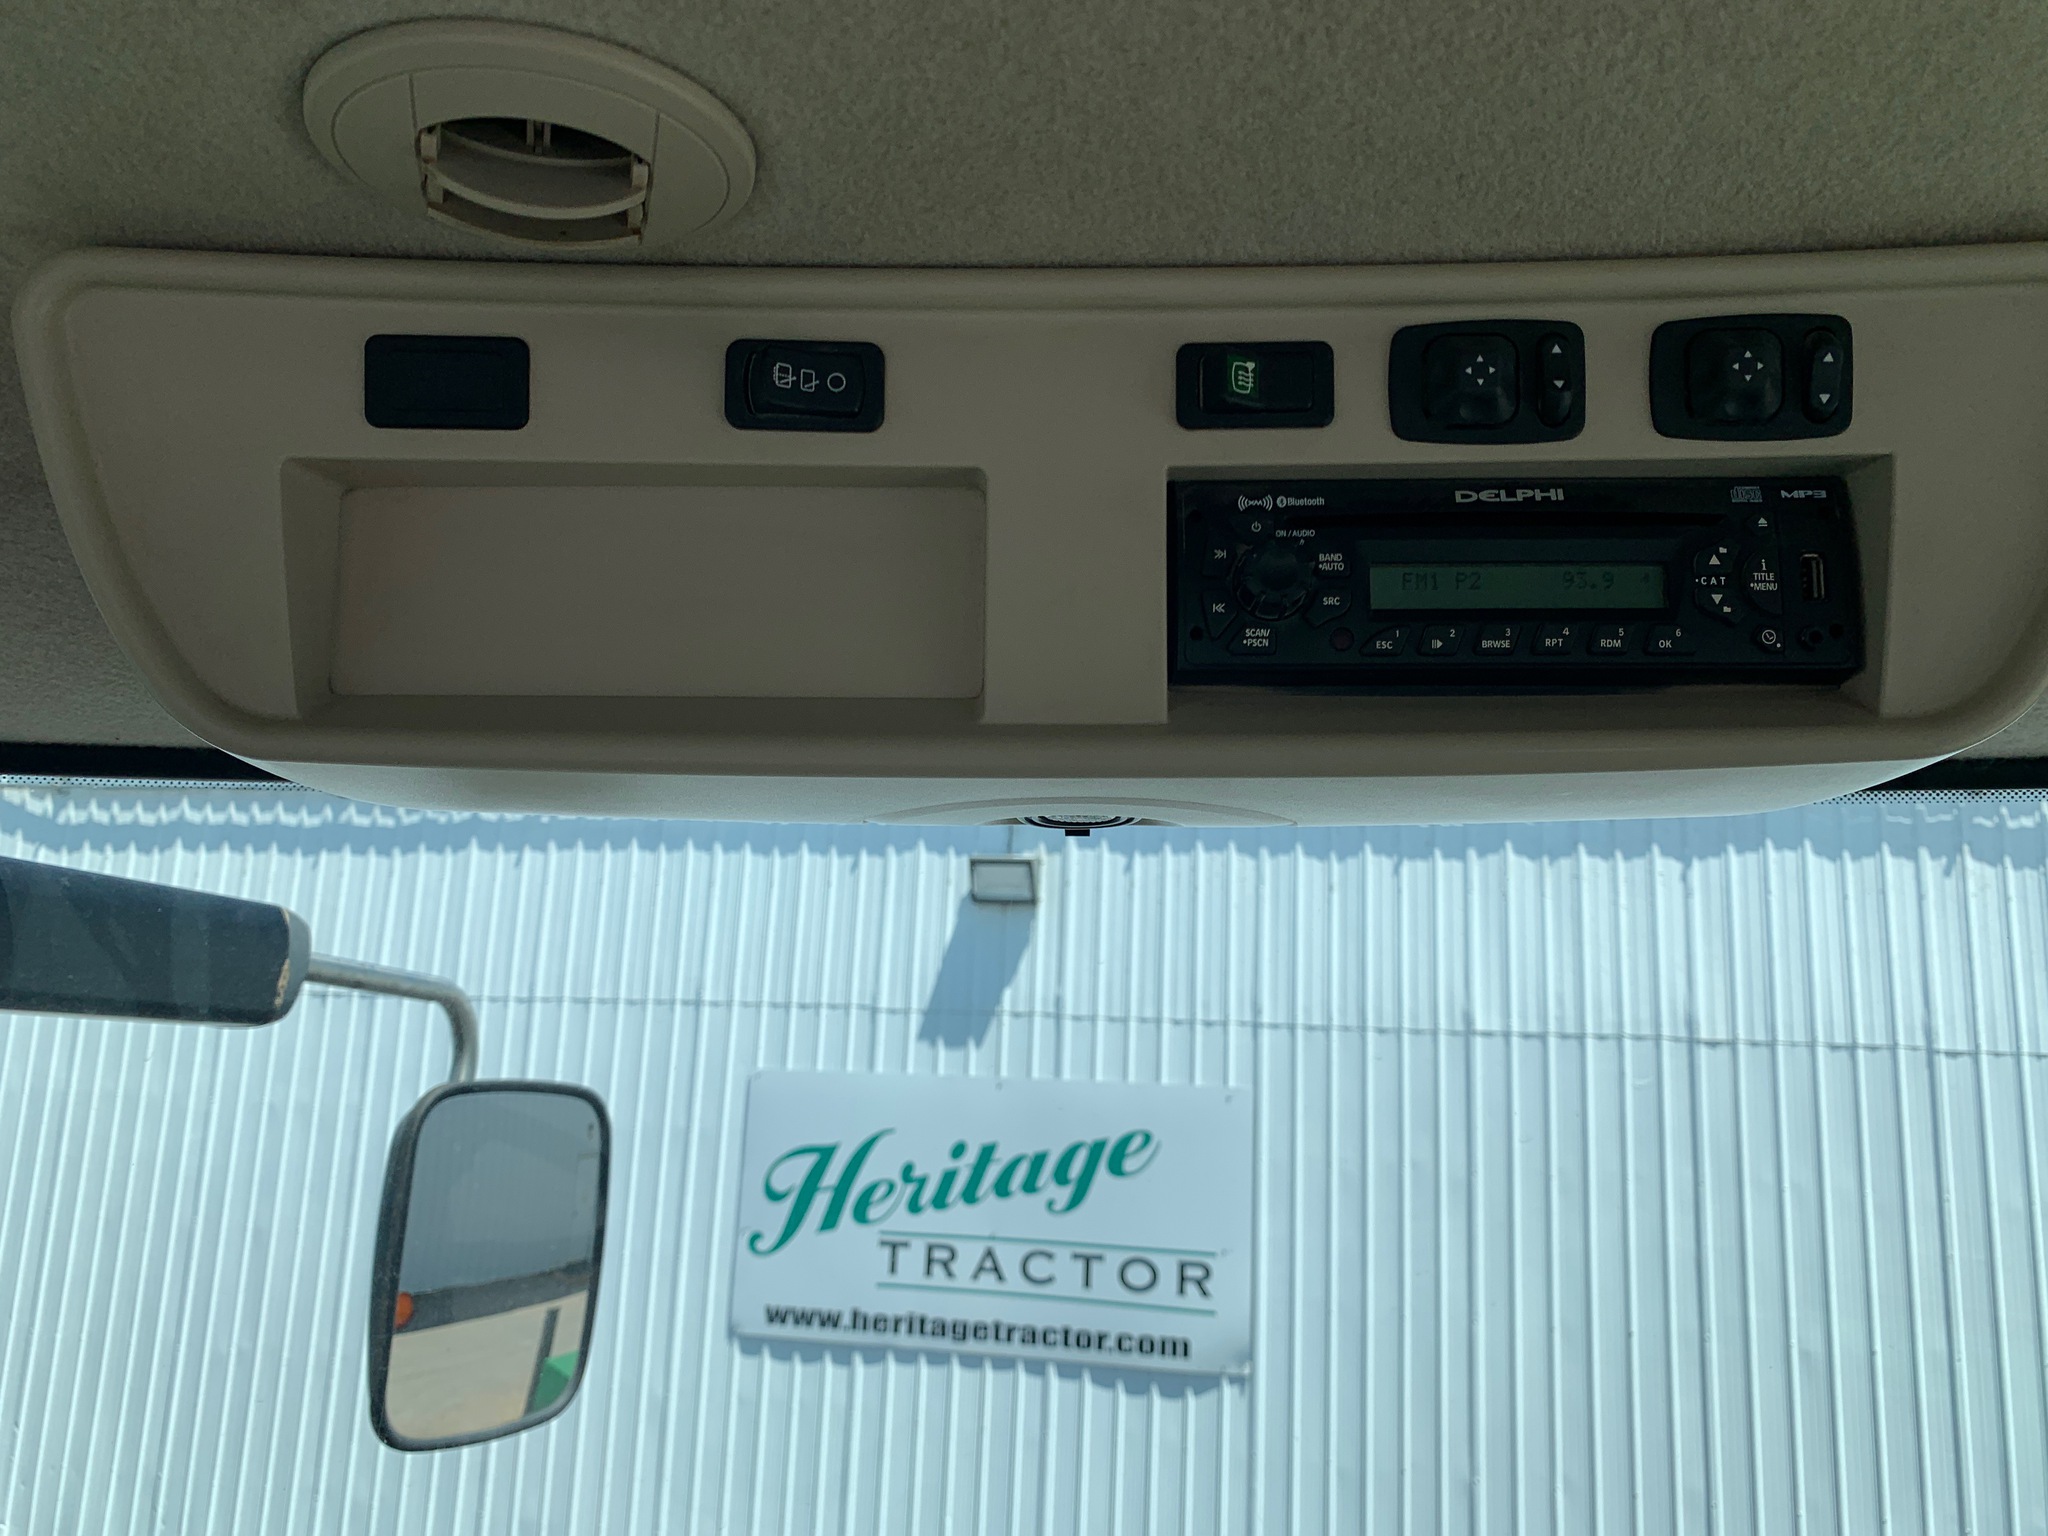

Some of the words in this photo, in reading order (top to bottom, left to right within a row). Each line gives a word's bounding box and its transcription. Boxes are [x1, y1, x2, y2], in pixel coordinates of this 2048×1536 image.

[1454, 488, 1565, 503] DELPHI
[1780, 490, 1827, 499] MP3
[1287, 496, 1325, 506] Bluetooth
[1292, 529, 1315, 537] AUDIO
[1319, 553, 1343, 562] BAND
[1402, 572, 1439, 590] FM1
[1455, 572, 1482, 590] P2
[1562, 571, 1615, 590] 93.9
[1753, 573, 1775, 581] TITLE
[1322, 597, 1341, 605] SRC
[1245, 628, 1270, 637] SCAN/
[1450, 630, 1456, 638] 2
[1505, 628, 1511, 637] 3
[1562, 628, 1570, 636] 4
[1618, 628, 1624, 637] 5
[1675, 629, 1682, 637] 6
[1376, 640, 1393, 650] ESC
[1481, 639, 1511, 649] BRWSE
[1545, 638, 1564, 648] RPT
[1600, 639, 1622, 648] RDM
[1658, 639, 1672, 649] OK
[748, 1128, 1161, 1257] Heritage
[879, 1239, 1214, 1297] TRACTOR
[764, 1304, 1191, 1359] www.heritagetractor.com
